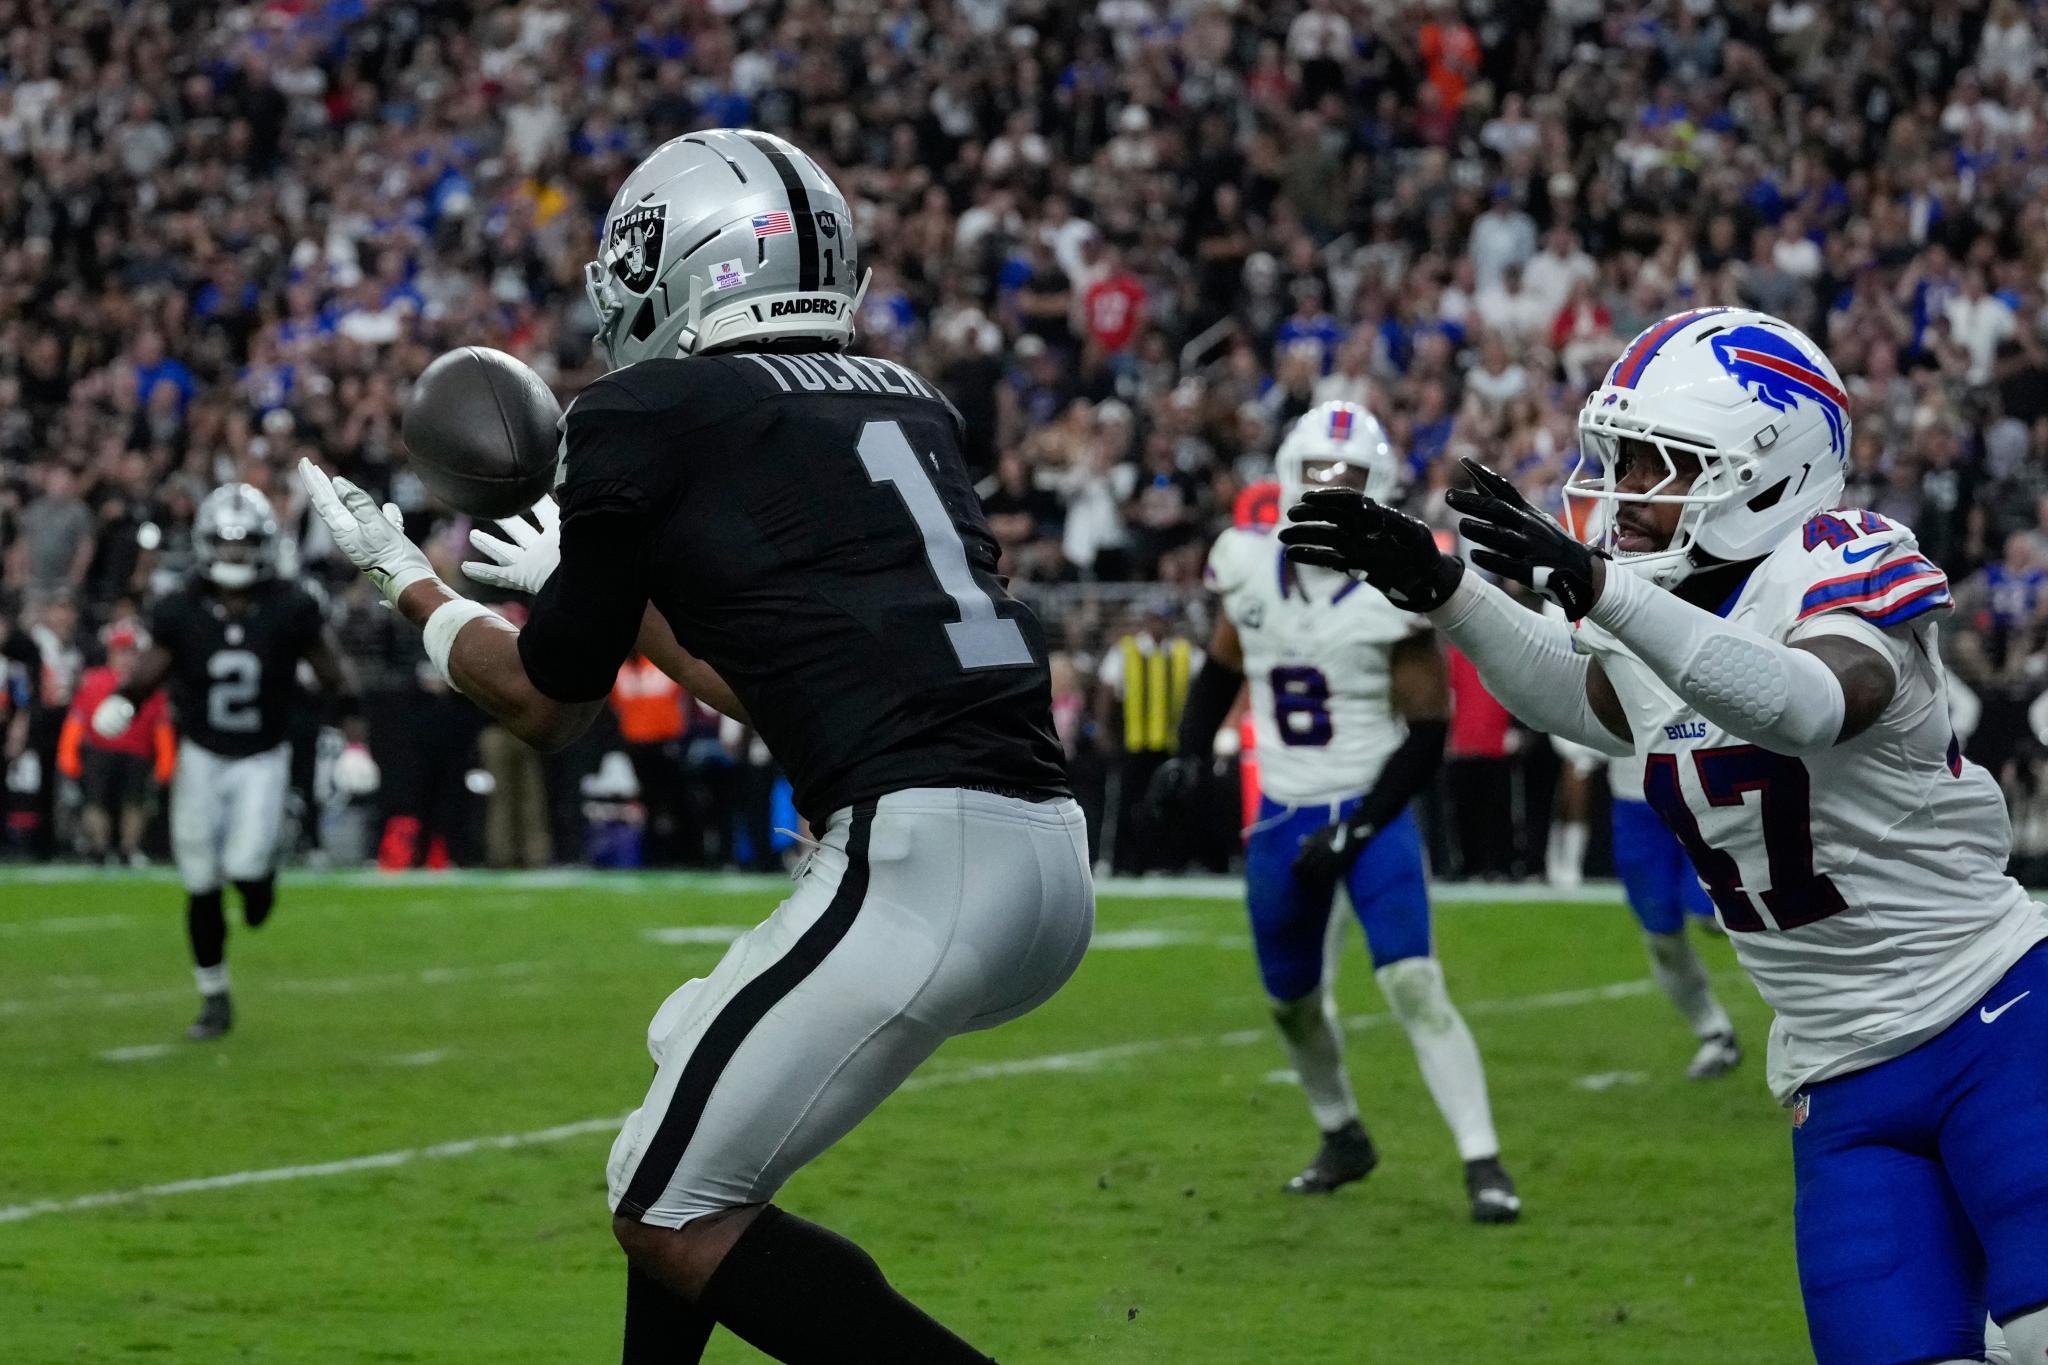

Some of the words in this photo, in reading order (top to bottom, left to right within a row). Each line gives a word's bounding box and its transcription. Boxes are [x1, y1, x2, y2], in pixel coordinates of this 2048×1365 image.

[615, 208, 660, 230] RAIDERS
[823, 248, 836, 286] 1
[770, 298, 837, 317] RAIDERS
[733, 352, 934, 398] TUCKER
[856, 420, 1036, 670] 1
[206, 650, 263, 732] 2
[1664, 722, 1706, 740] BILLS
[1643, 744, 1850, 933] 47
